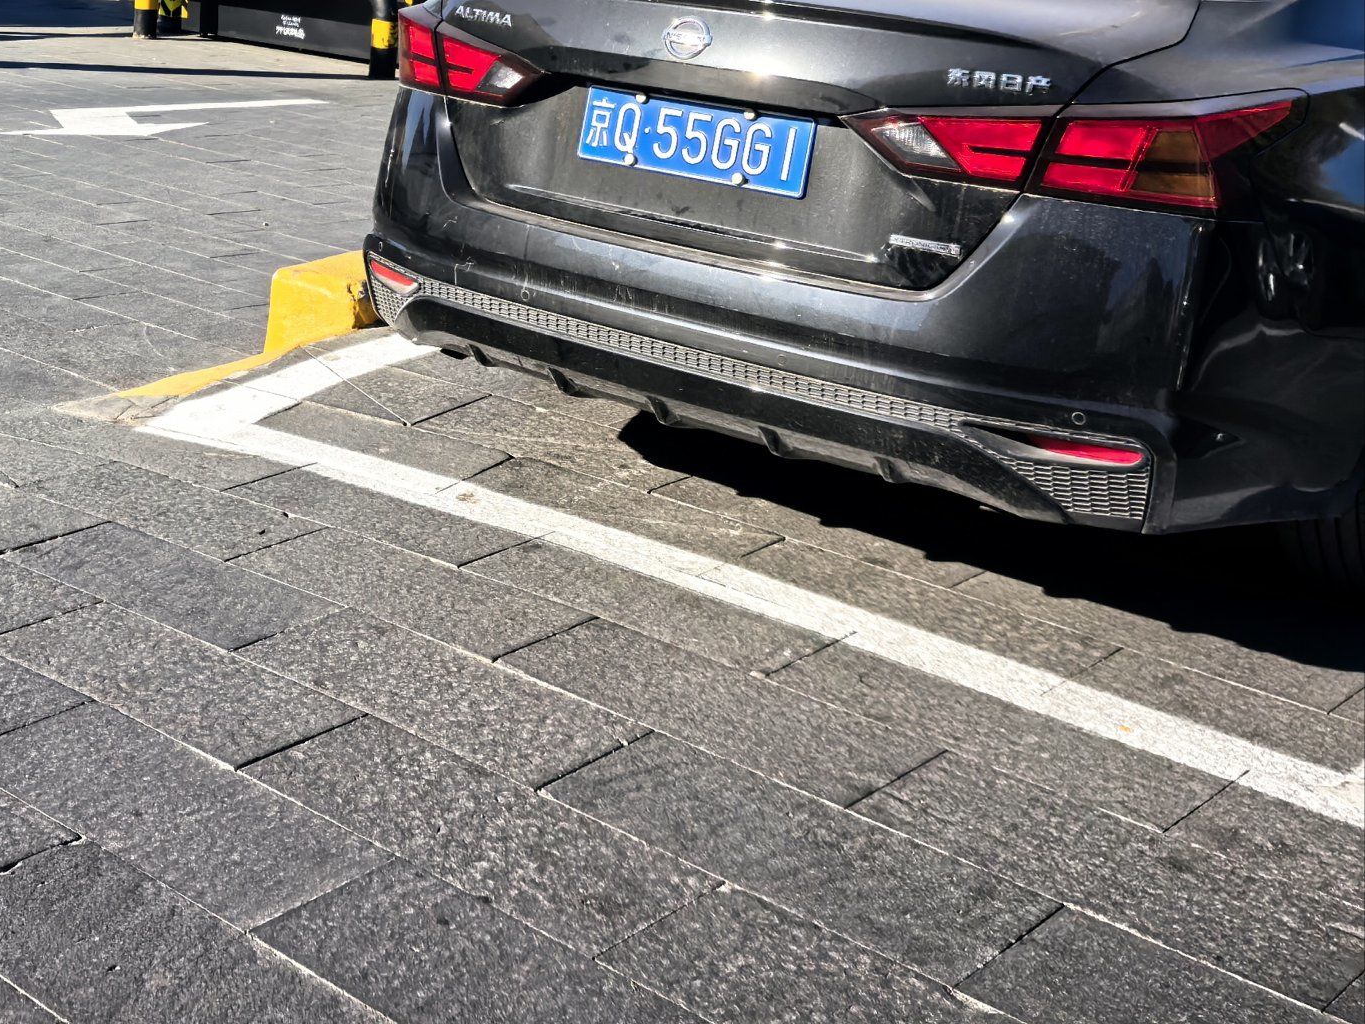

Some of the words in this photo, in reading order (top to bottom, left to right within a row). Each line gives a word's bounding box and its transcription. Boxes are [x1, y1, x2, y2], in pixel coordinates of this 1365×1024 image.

[455, 5, 512, 27] ALTIMA
[947, 67, 1051, 95] 东风日产
